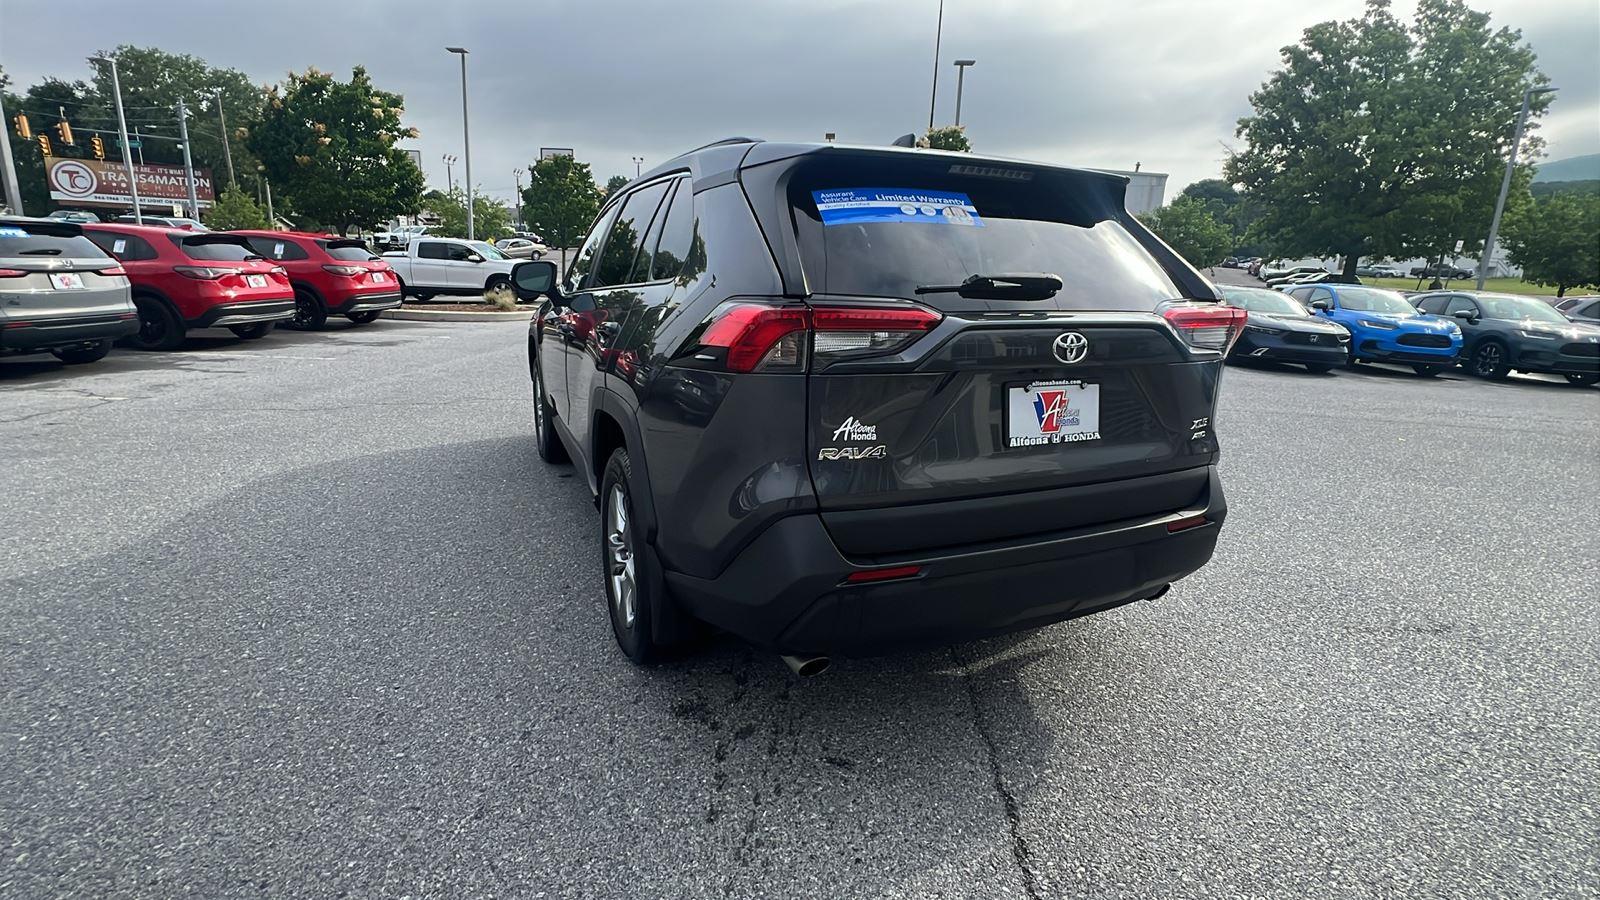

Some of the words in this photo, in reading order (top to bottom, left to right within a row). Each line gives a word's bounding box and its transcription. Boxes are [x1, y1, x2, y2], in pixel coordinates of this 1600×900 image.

[98, 170, 210, 188] TRAS4MATION
[141, 183, 211, 195] CHURH
[875, 193, 916, 203] Limited
[917, 195, 965, 207] Warranty
[832, 416, 876, 441] Altoona
[851, 432, 877, 441] Honda
[1009, 436, 1049, 448] Altoona
[1064, 431, 1101, 443] HONDA
[817, 445, 887, 461] RAV4
